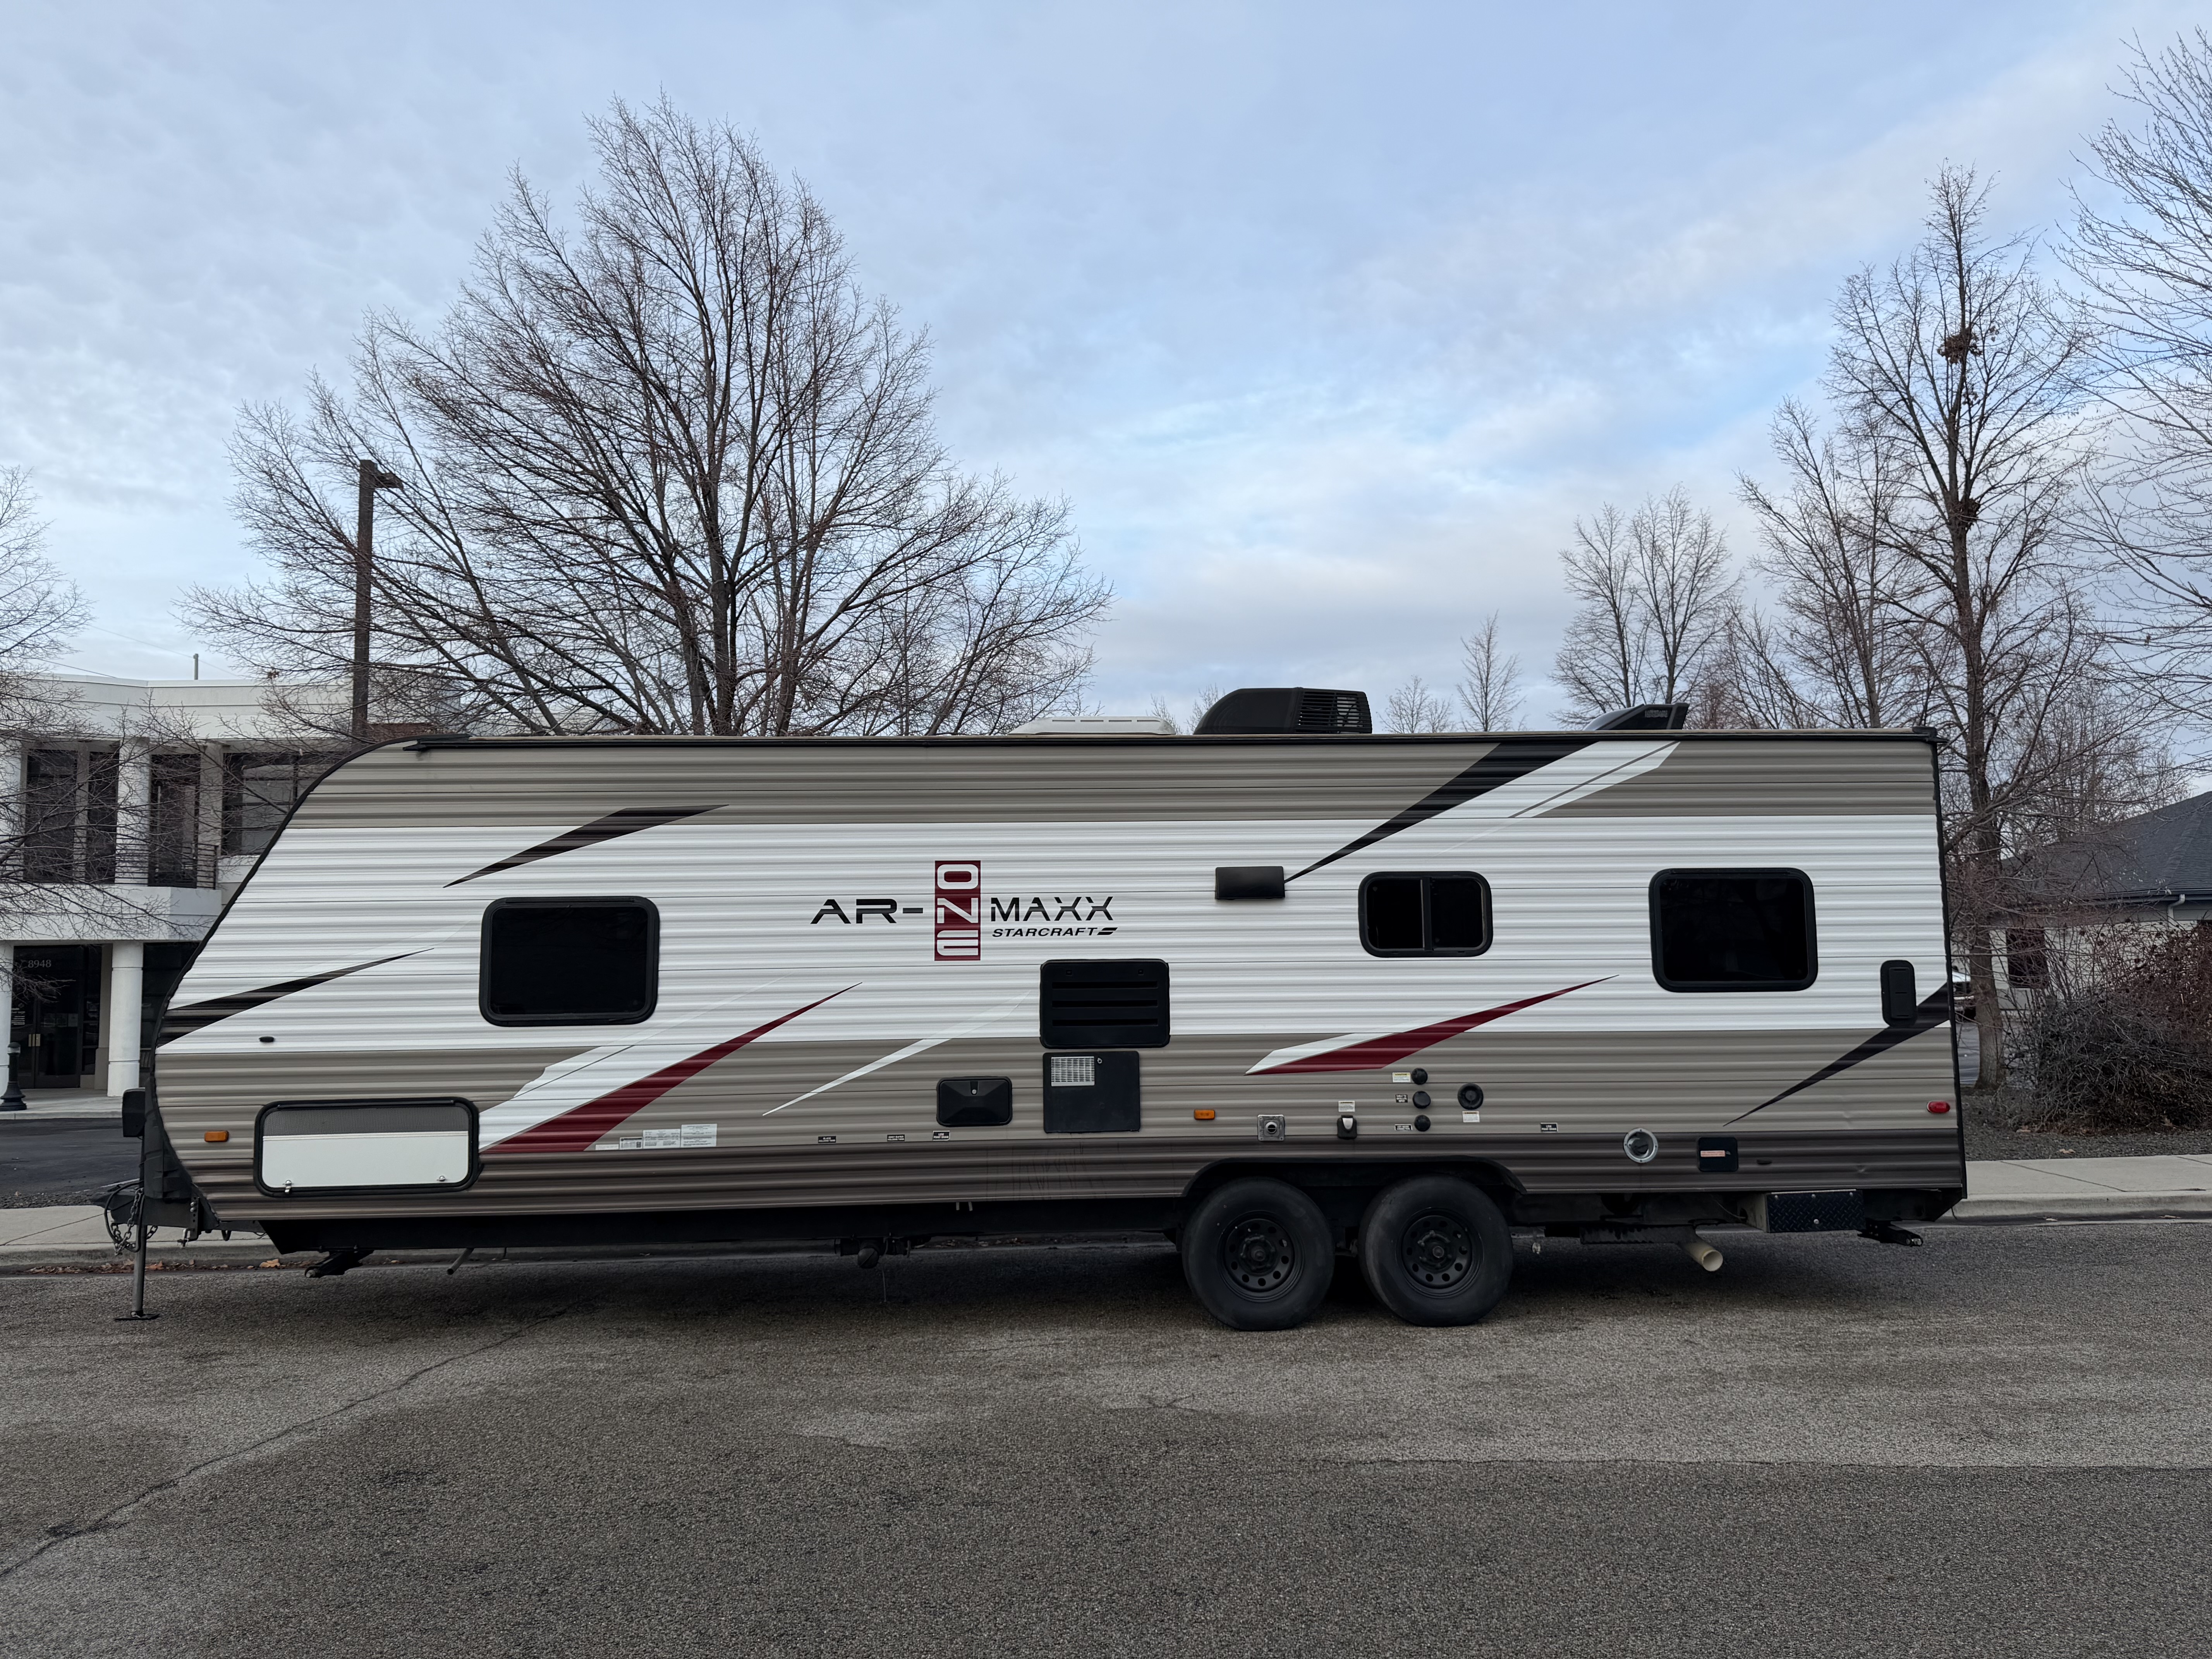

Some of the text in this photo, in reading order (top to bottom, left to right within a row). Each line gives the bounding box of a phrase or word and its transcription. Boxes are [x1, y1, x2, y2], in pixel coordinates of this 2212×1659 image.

[810, 864, 1113, 956] AR- ONE MAXX
[992, 927, 1097, 937] STARCRAFT
[28, 960, 52, 968] 8948
